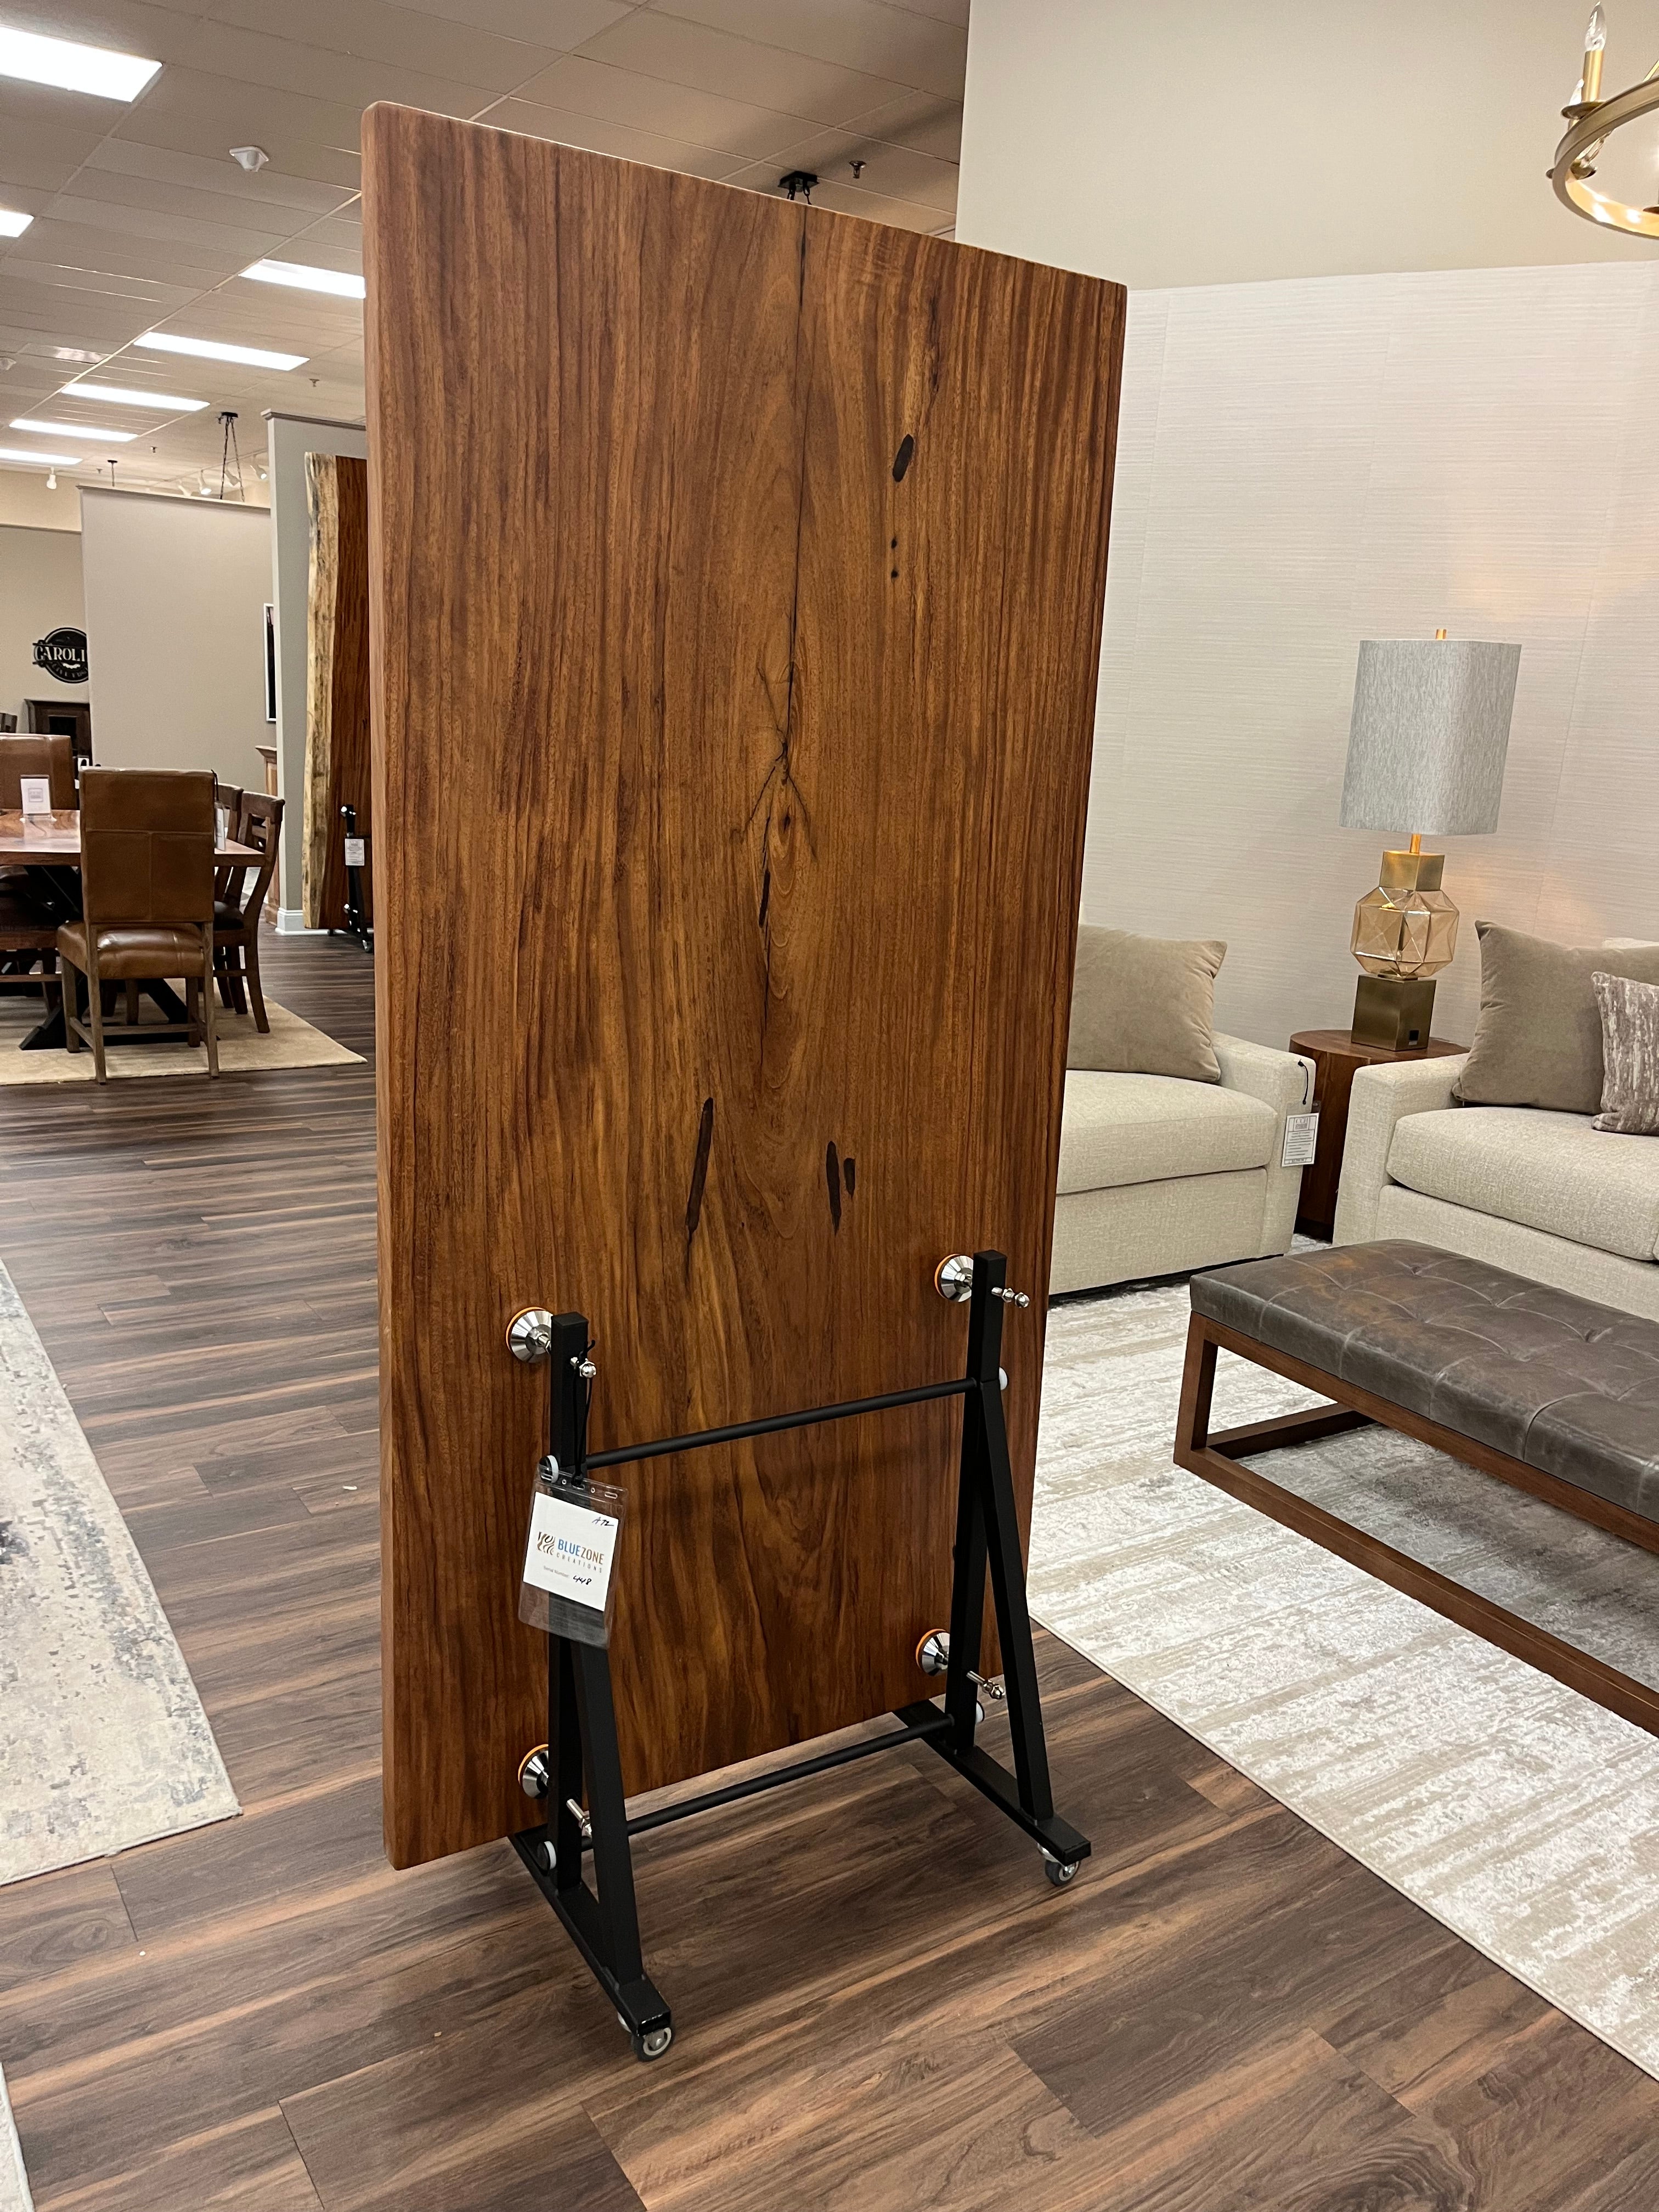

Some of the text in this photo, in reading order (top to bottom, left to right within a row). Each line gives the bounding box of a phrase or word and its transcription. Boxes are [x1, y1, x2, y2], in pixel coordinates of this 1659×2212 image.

[558, 1539, 604, 1565] BLUEZONE
[557, 1553, 602, 1573] CREATIONS
[573, 1575, 592, 1585] 448
